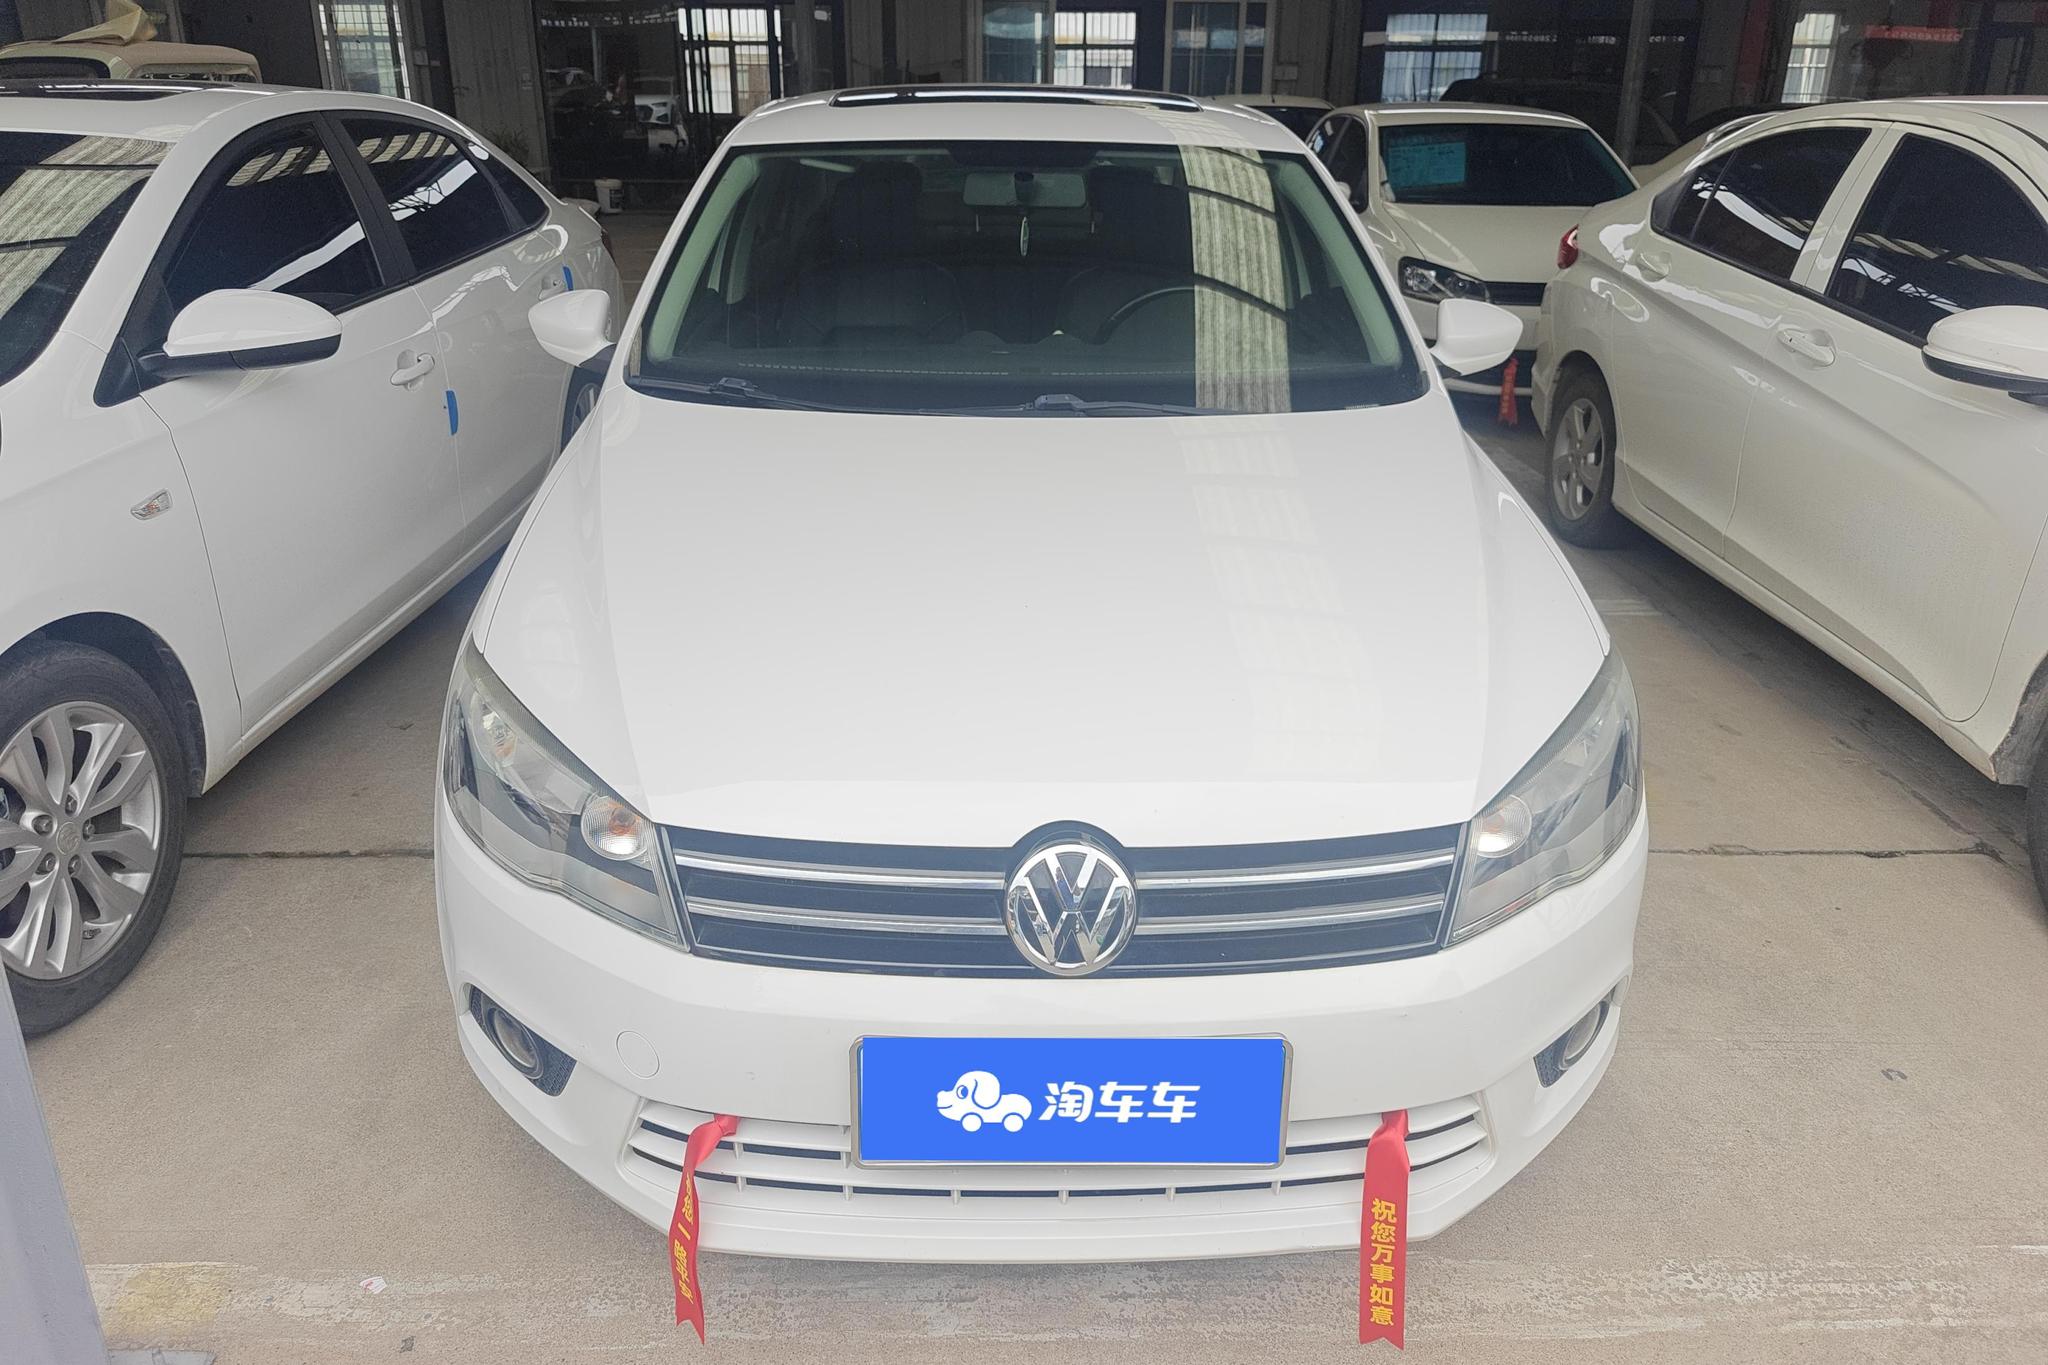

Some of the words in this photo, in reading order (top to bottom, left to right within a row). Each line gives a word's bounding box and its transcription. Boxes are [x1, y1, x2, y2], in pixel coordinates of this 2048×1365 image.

[1369, 1198, 1398, 1326] 祝您万事如意
